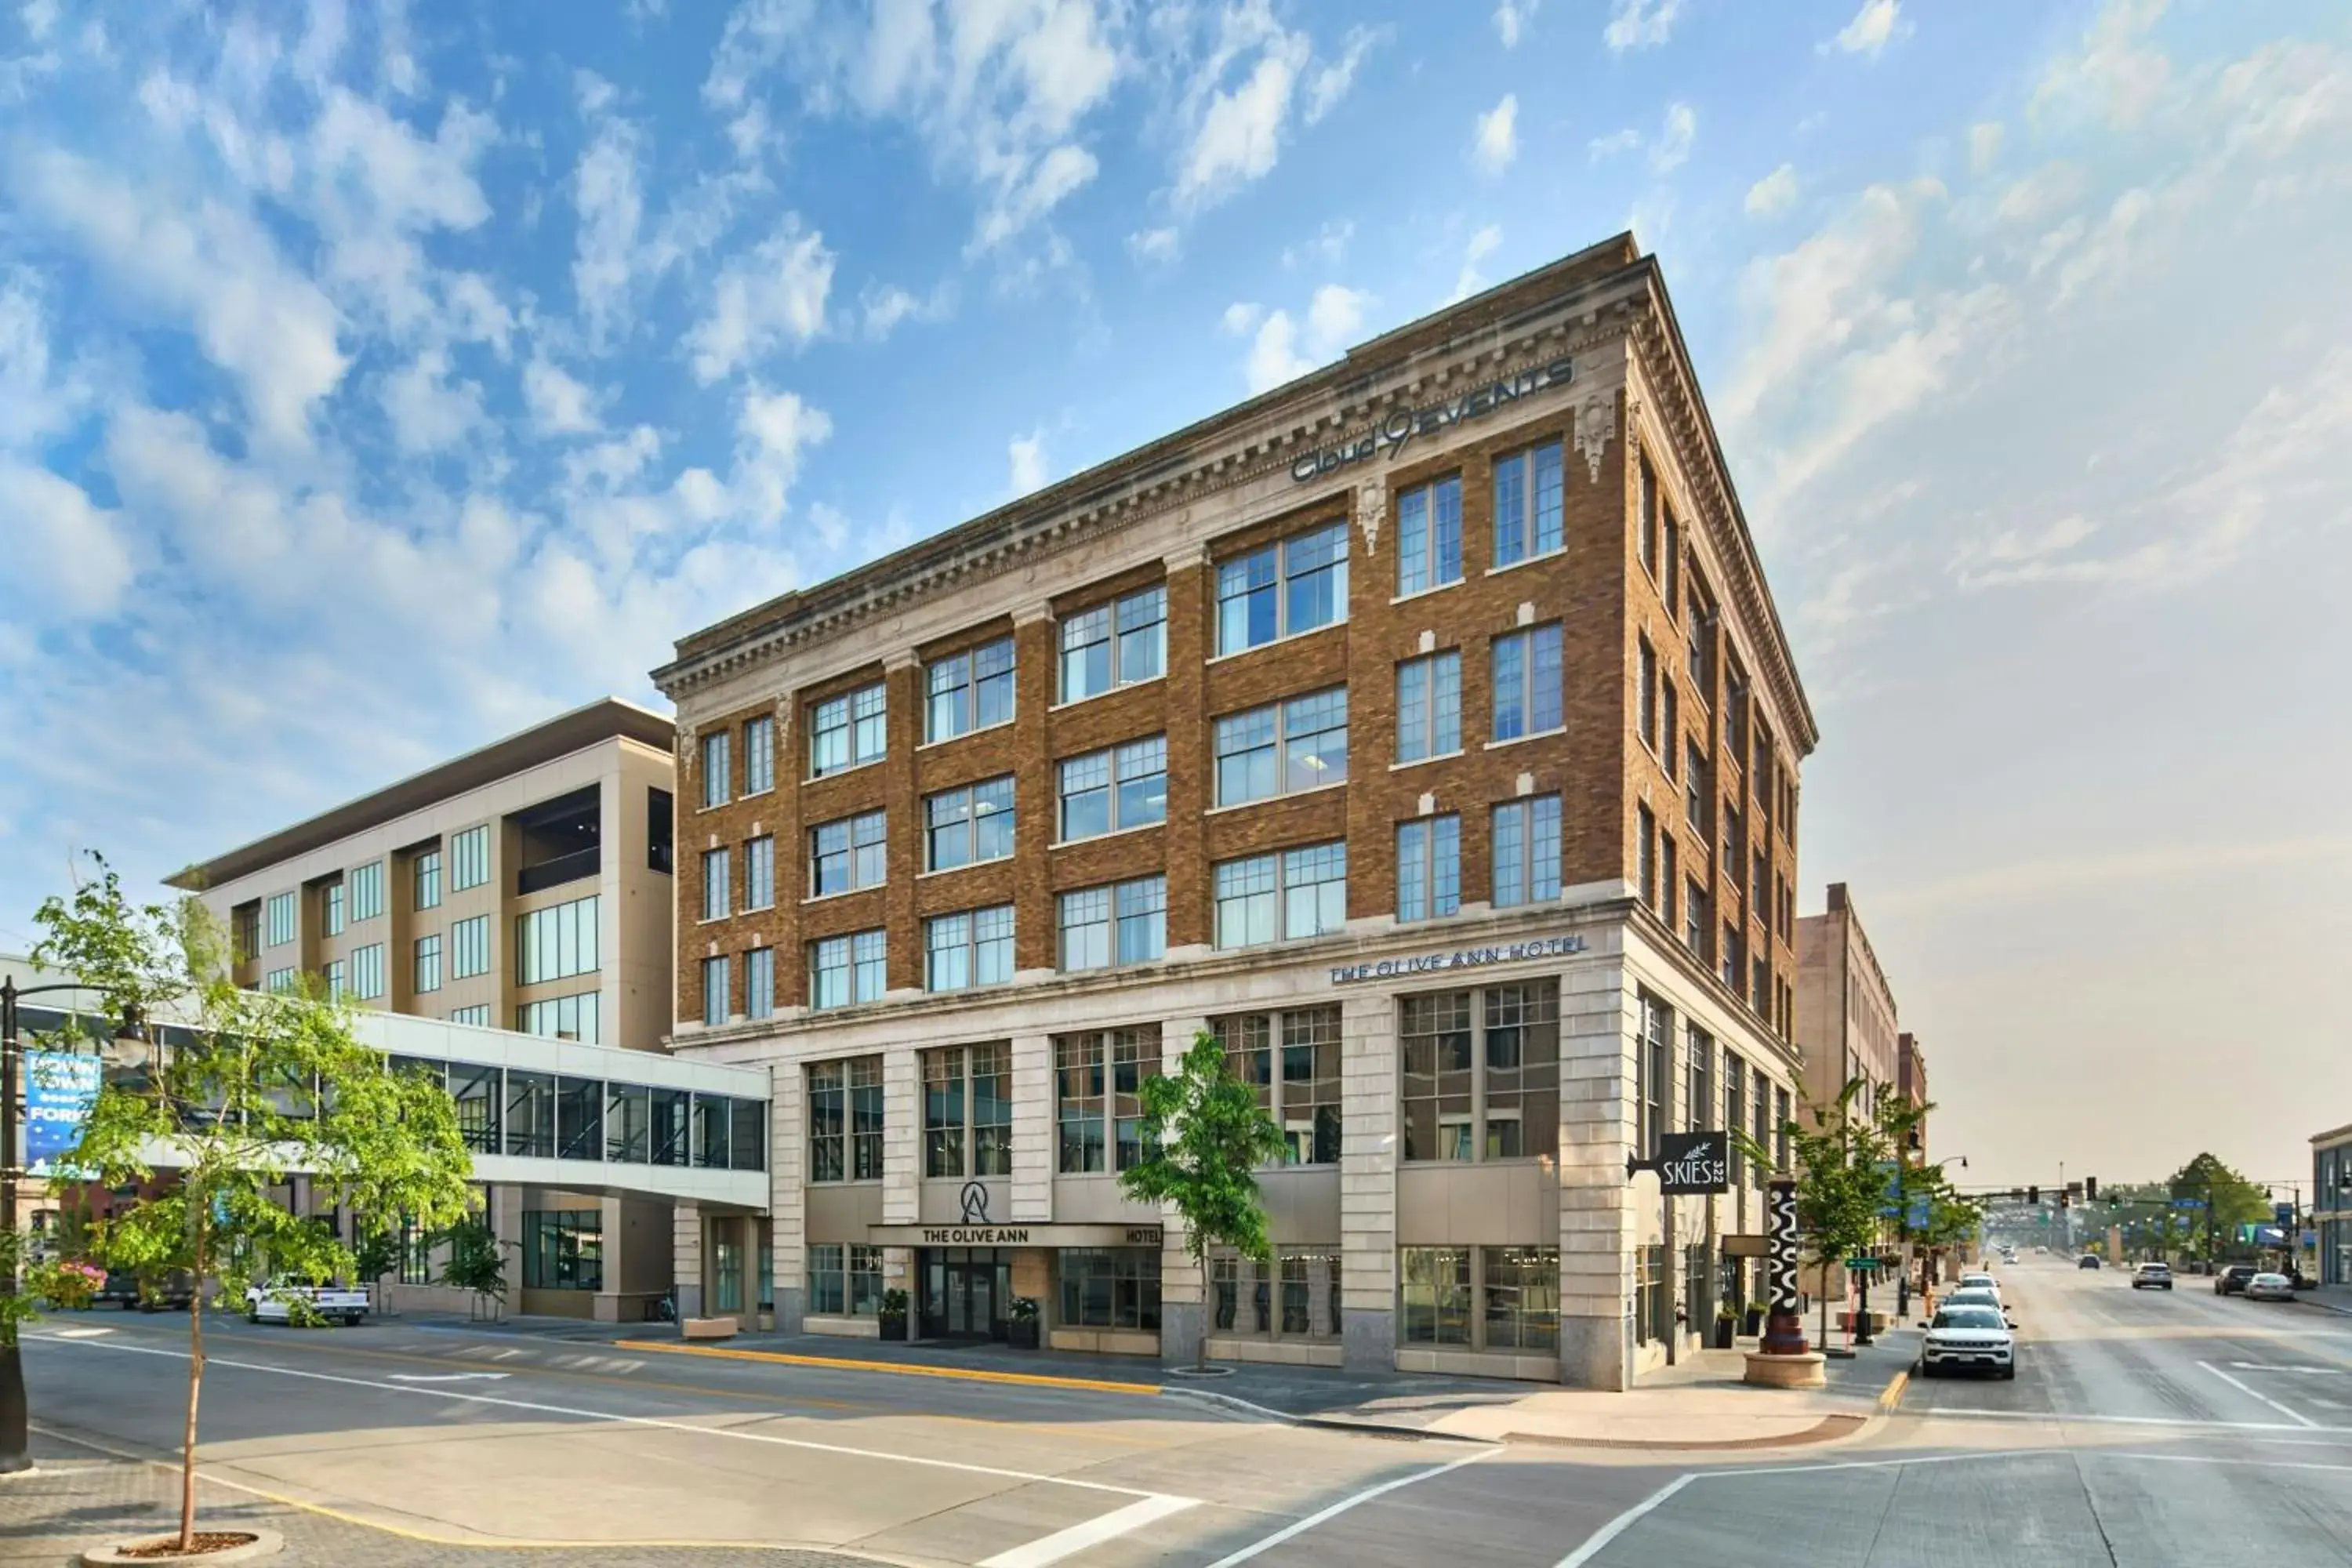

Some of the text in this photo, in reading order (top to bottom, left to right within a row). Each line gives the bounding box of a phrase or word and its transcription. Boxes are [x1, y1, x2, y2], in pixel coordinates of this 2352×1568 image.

[1418, 355, 1575, 437] EVENTS
[1330, 935, 1588, 985] THE OLIVE ANN HOTEL
[1663, 1160, 1712, 1185] SKIES
[1713, 1160, 1725, 1183] 322
[923, 1229, 1029, 1243] THE OLIVE ANN
[1126, 1229, 1161, 1243] HOTEL
